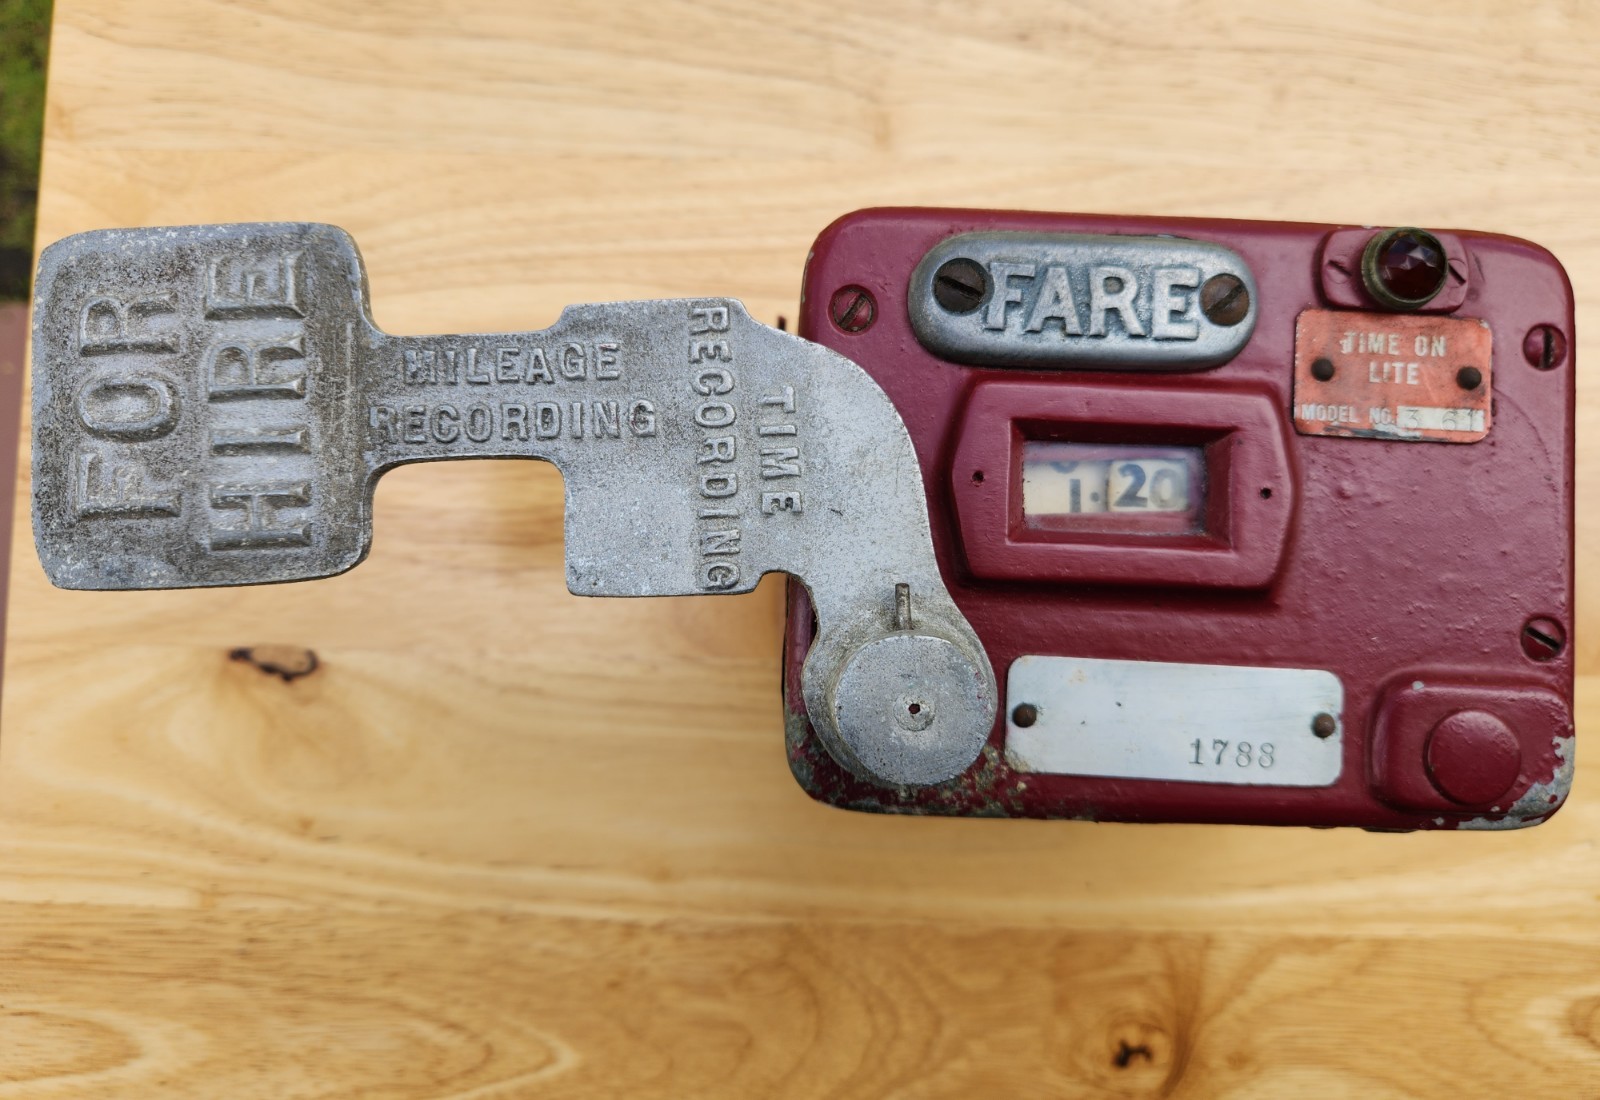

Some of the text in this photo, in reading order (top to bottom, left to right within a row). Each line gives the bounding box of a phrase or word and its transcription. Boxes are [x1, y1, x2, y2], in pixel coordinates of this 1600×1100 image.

[984, 261, 1199, 341] FARE
[402, 342, 621, 386] MILEAGE
[1340, 331, 1447, 357] TIME ON
[1368, 362, 1420, 385] LITE
[79, 291, 182, 525] FOR
[205, 250, 312, 551] HIRE
[369, 401, 657, 443] RECORDING
[1301, 403, 1360, 423] MODEL
[688, 306, 742, 590] RECORDING
[758, 386, 802, 515] TIME
[1188, 738, 1275, 768] 1788
